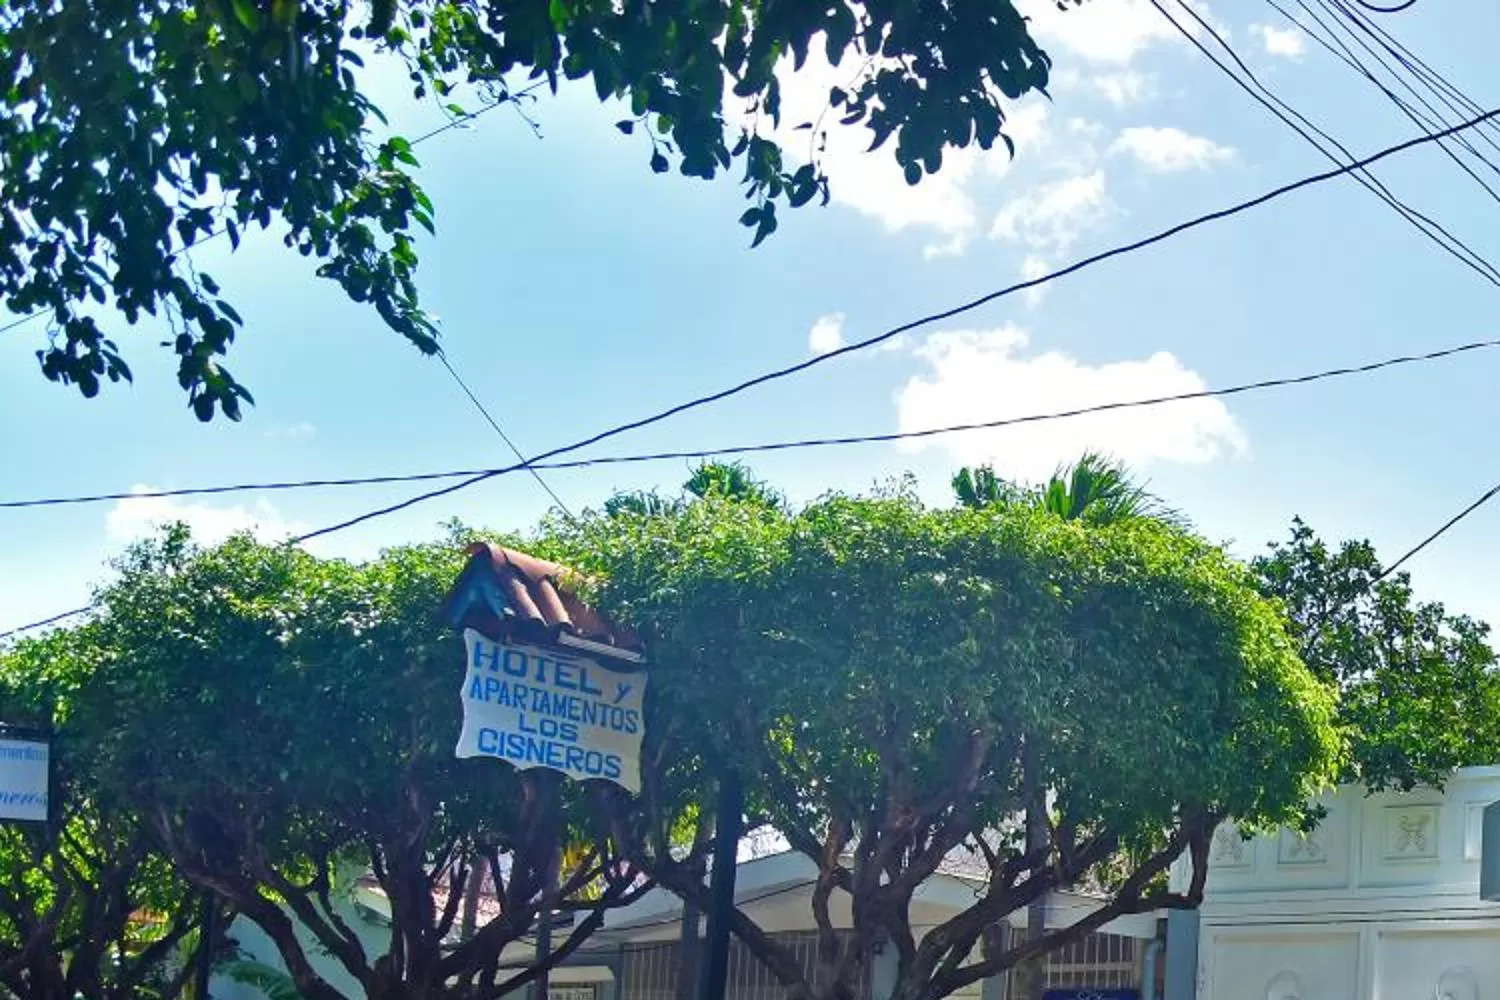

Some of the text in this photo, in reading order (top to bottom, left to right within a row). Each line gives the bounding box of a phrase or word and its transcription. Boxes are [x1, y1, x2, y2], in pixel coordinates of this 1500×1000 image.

[473, 641, 632, 704] HOTEL y
[470, 676, 639, 734] APARTAMENTOS
[519, 713, 579, 743] LOS
[478, 728, 622, 779] CISNEROS
